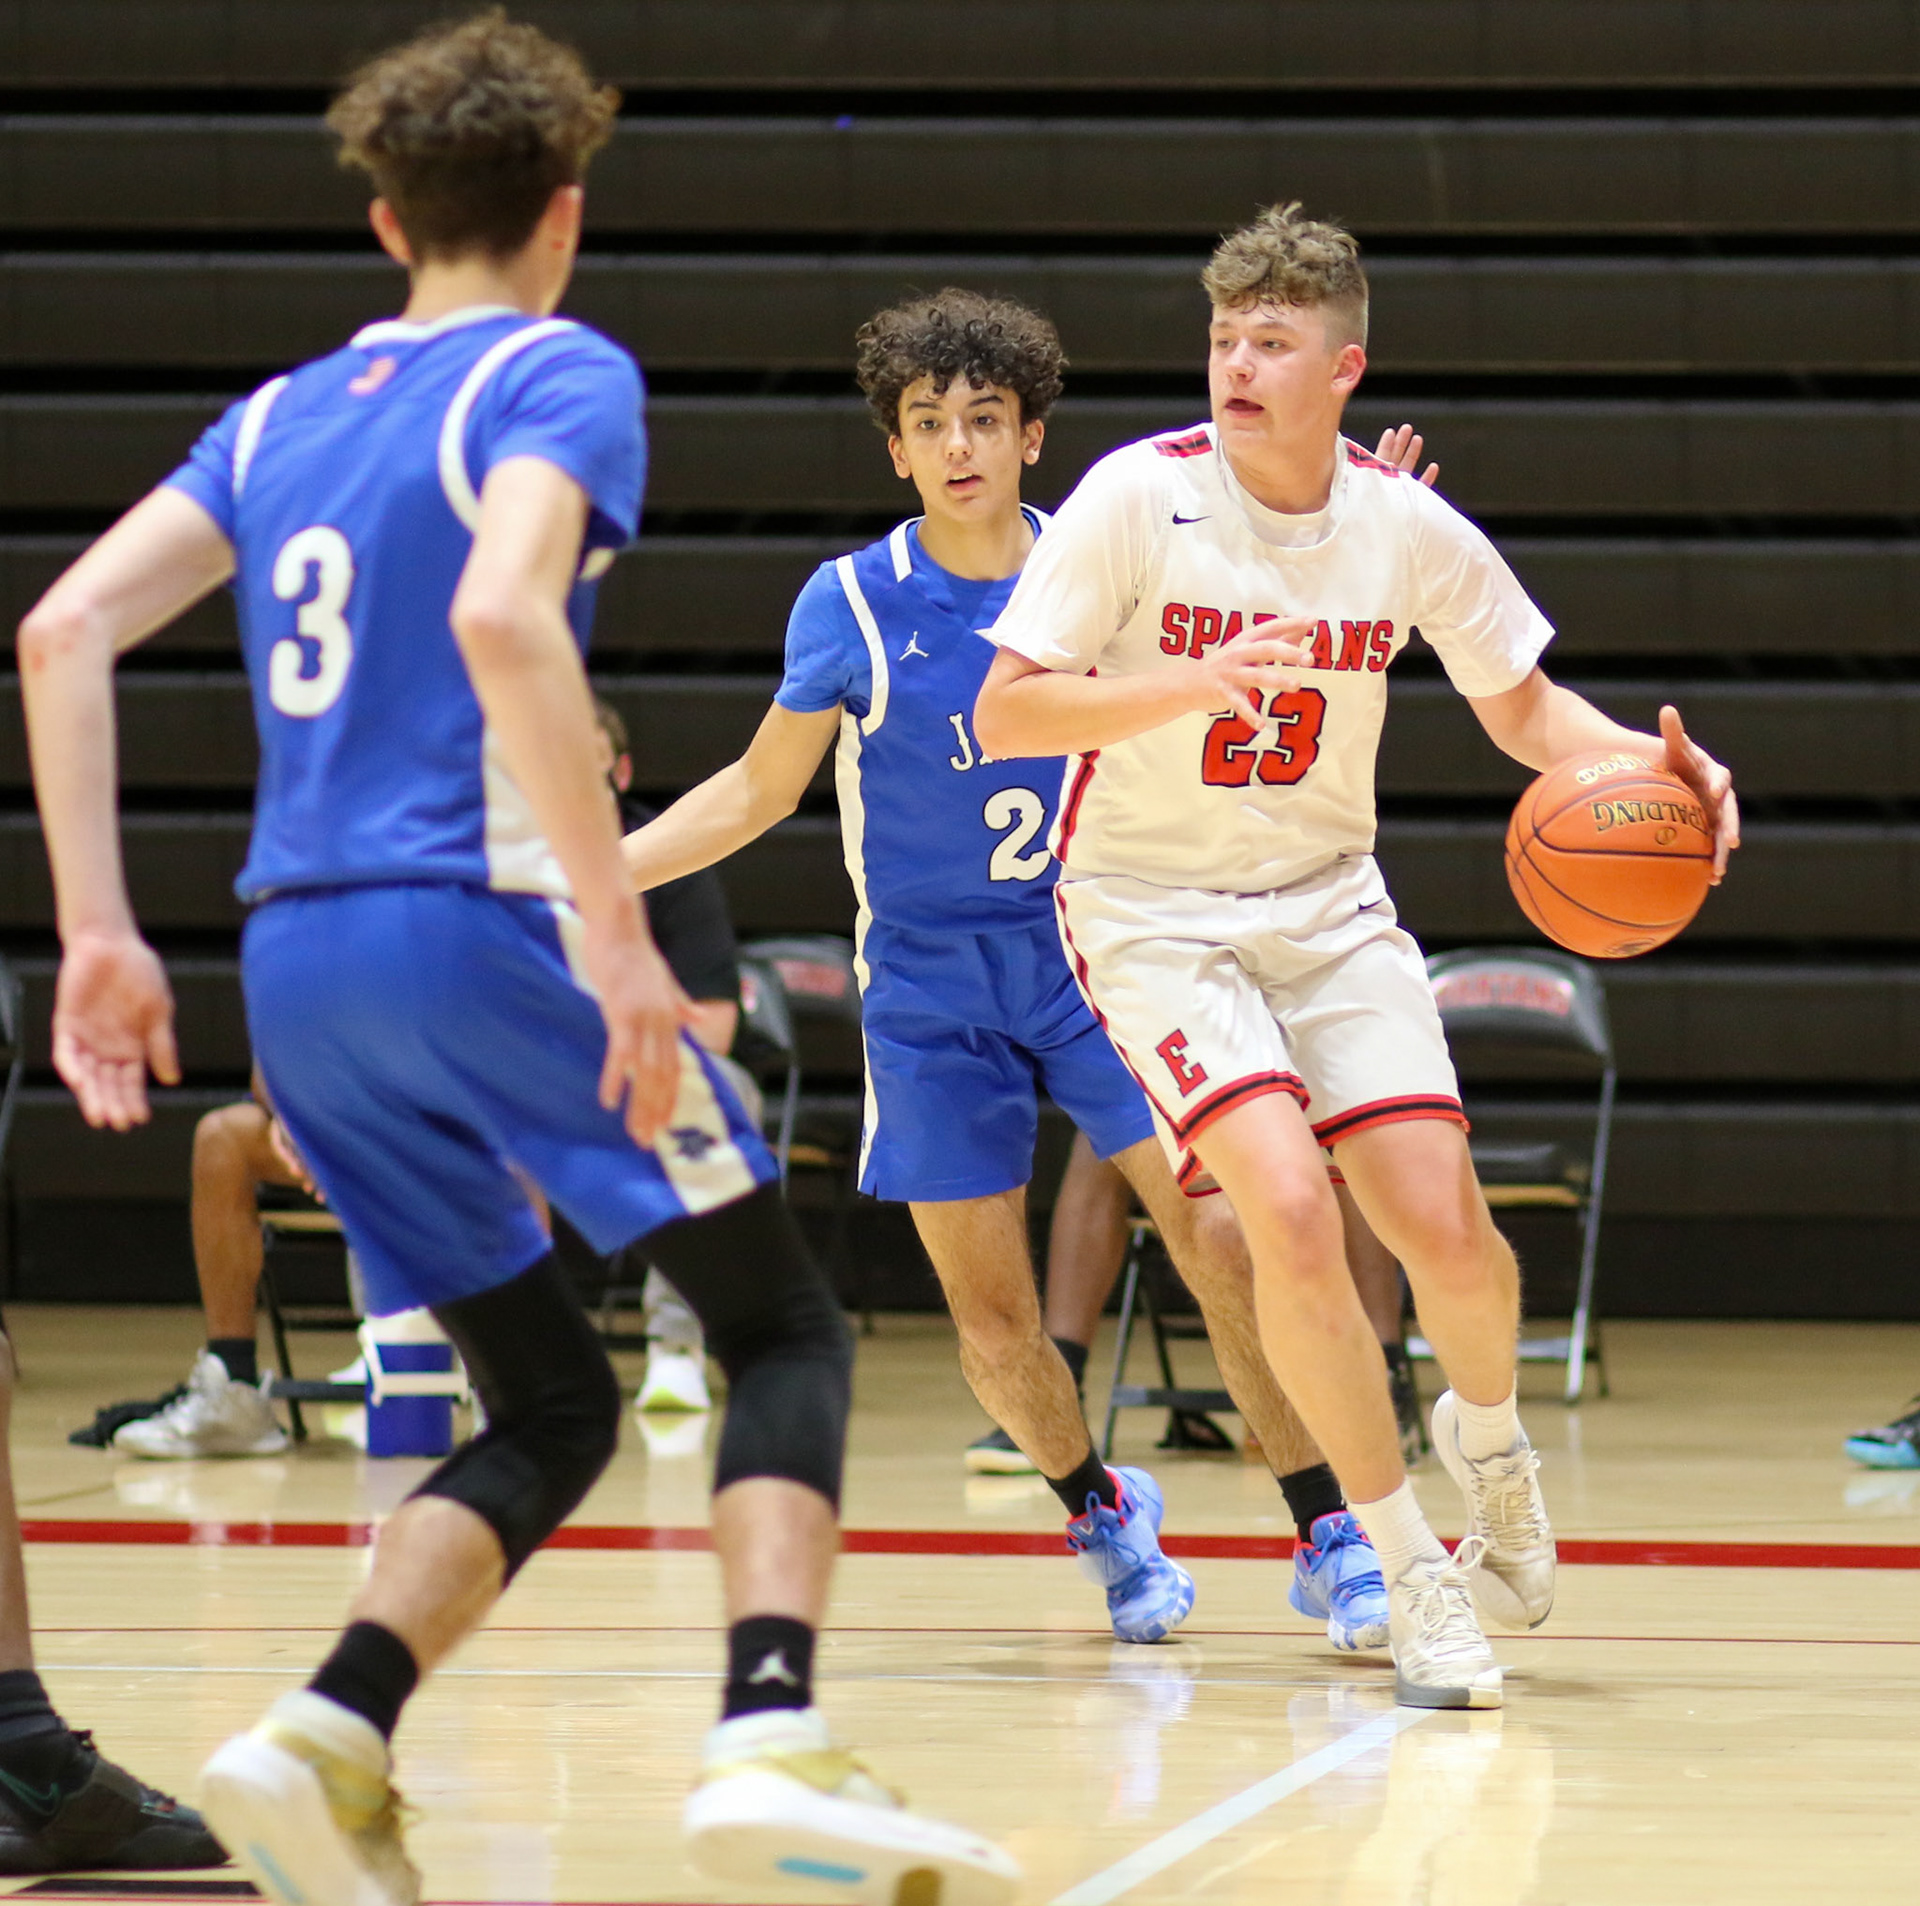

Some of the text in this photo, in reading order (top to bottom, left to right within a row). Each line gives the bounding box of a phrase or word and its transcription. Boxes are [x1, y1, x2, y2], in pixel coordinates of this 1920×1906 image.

[270, 526, 354, 717] 3
[1159, 602, 1394, 672] SPAANS
[1202, 687, 1327, 787] 23
[983, 786, 1052, 882] 2
[1155, 1028, 1209, 1098] E
